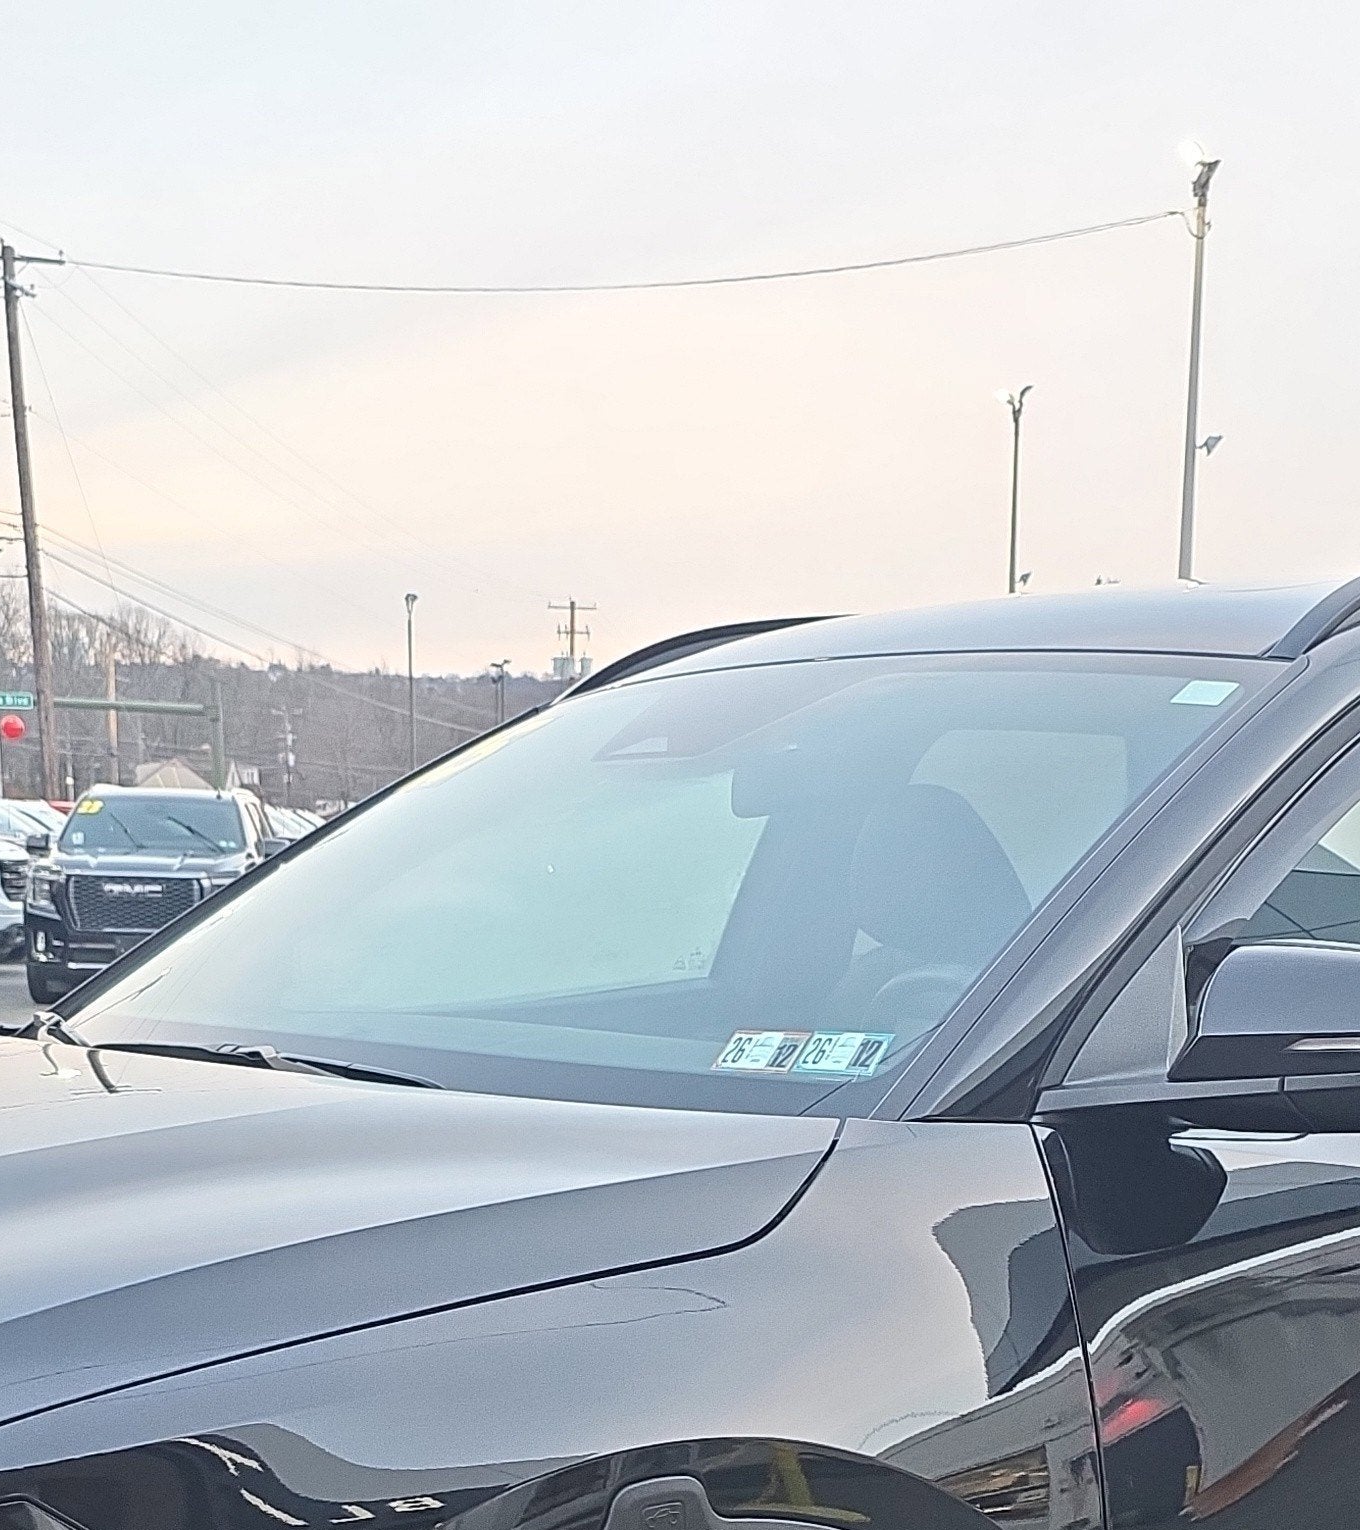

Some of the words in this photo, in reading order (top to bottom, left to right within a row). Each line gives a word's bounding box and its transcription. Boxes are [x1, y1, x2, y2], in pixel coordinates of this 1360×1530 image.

[721, 1036, 753, 1064] 26
[766, 1042, 800, 1069] 12
[801, 1036, 834, 1066] 26
[850, 1038, 885, 1069] 12
